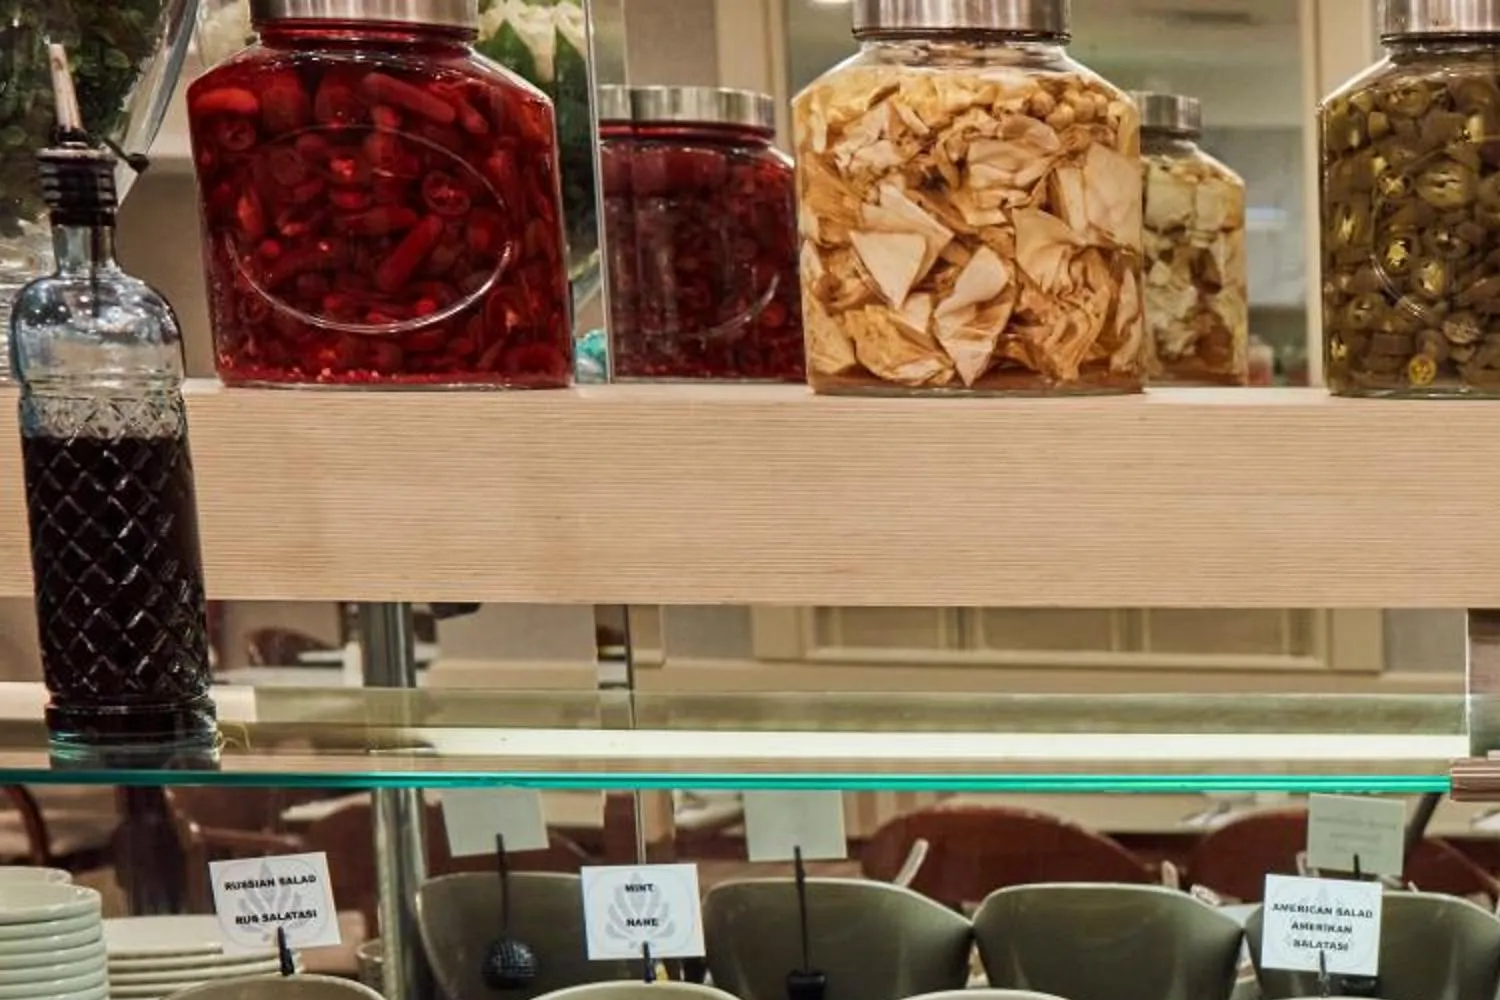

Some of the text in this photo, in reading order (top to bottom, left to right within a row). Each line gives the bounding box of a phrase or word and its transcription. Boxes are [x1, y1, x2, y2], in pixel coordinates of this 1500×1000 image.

[225, 876, 316, 891] RUSSIAN SALAD
[625, 884, 654, 893] MINT
[235, 910, 317, 924] RUS SALATASI
[1272, 904, 1372, 918] AMERICAN SALAD
[626, 918, 659, 927] NANE
[1293, 940, 1348, 951] SALATASI
